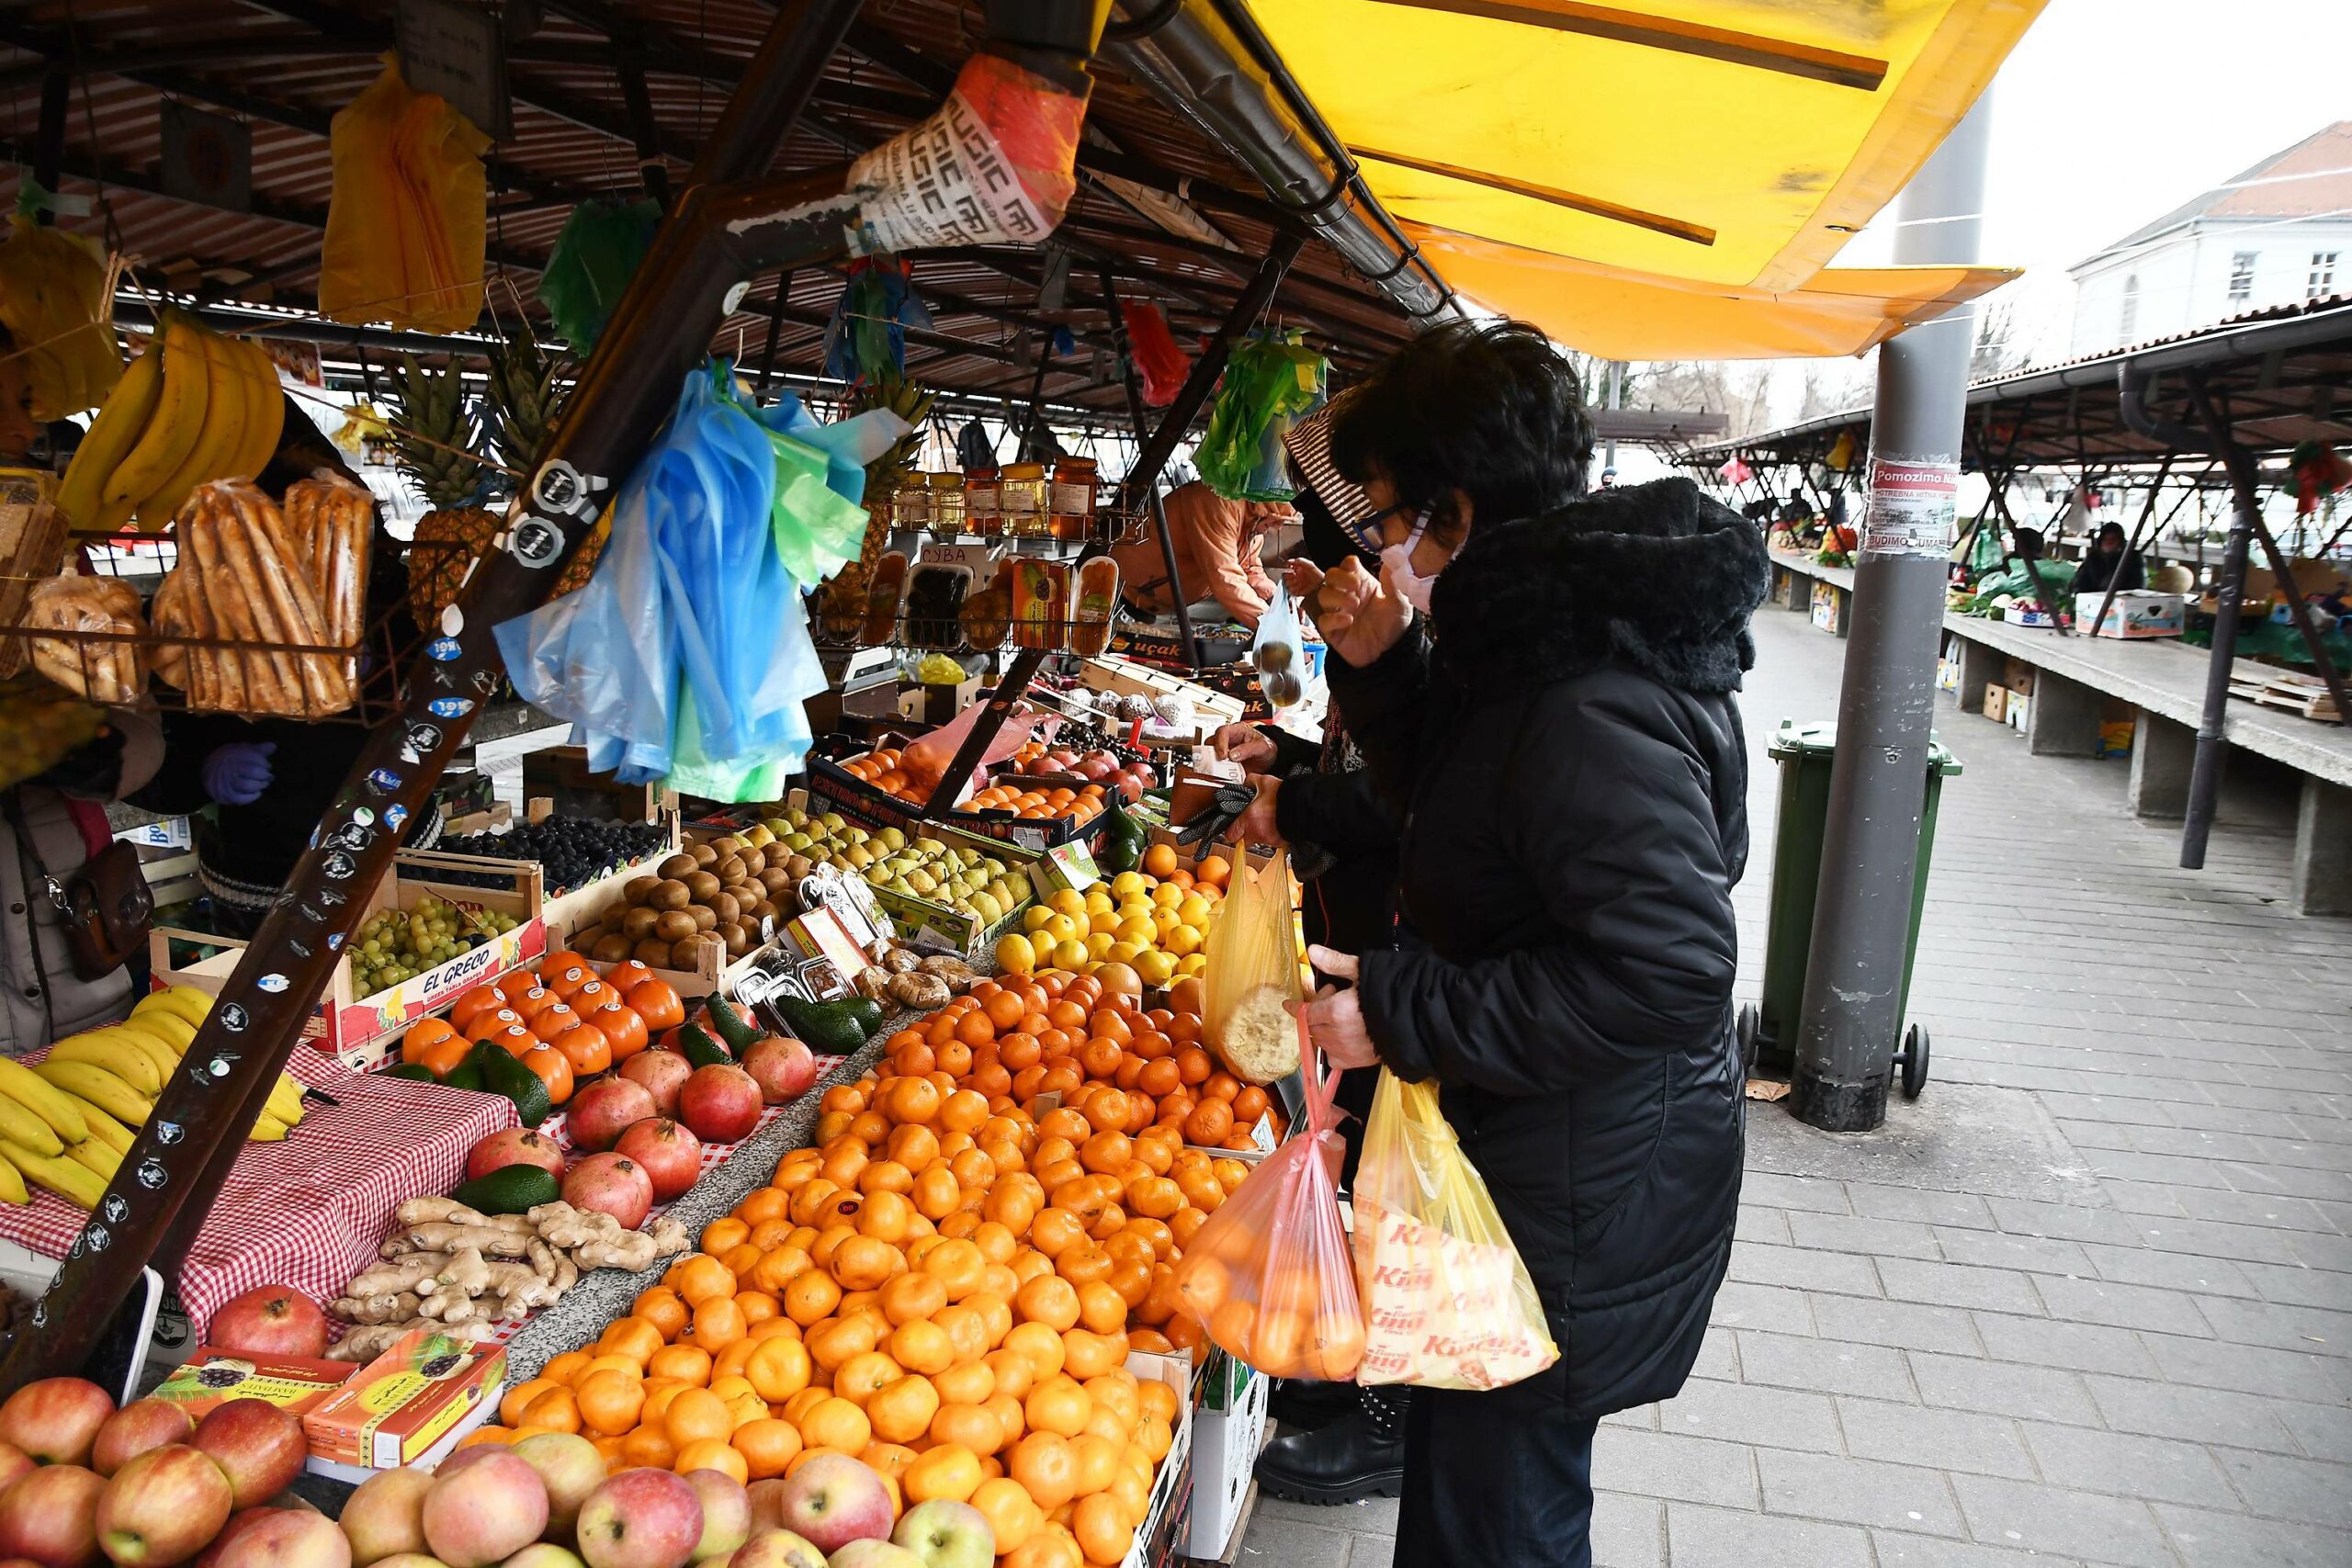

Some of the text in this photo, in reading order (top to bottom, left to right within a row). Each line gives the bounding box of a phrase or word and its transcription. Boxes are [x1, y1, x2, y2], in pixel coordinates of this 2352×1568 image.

[1134, 642, 1182, 657] uçak
[424, 949, 489, 994] EL GRECO
